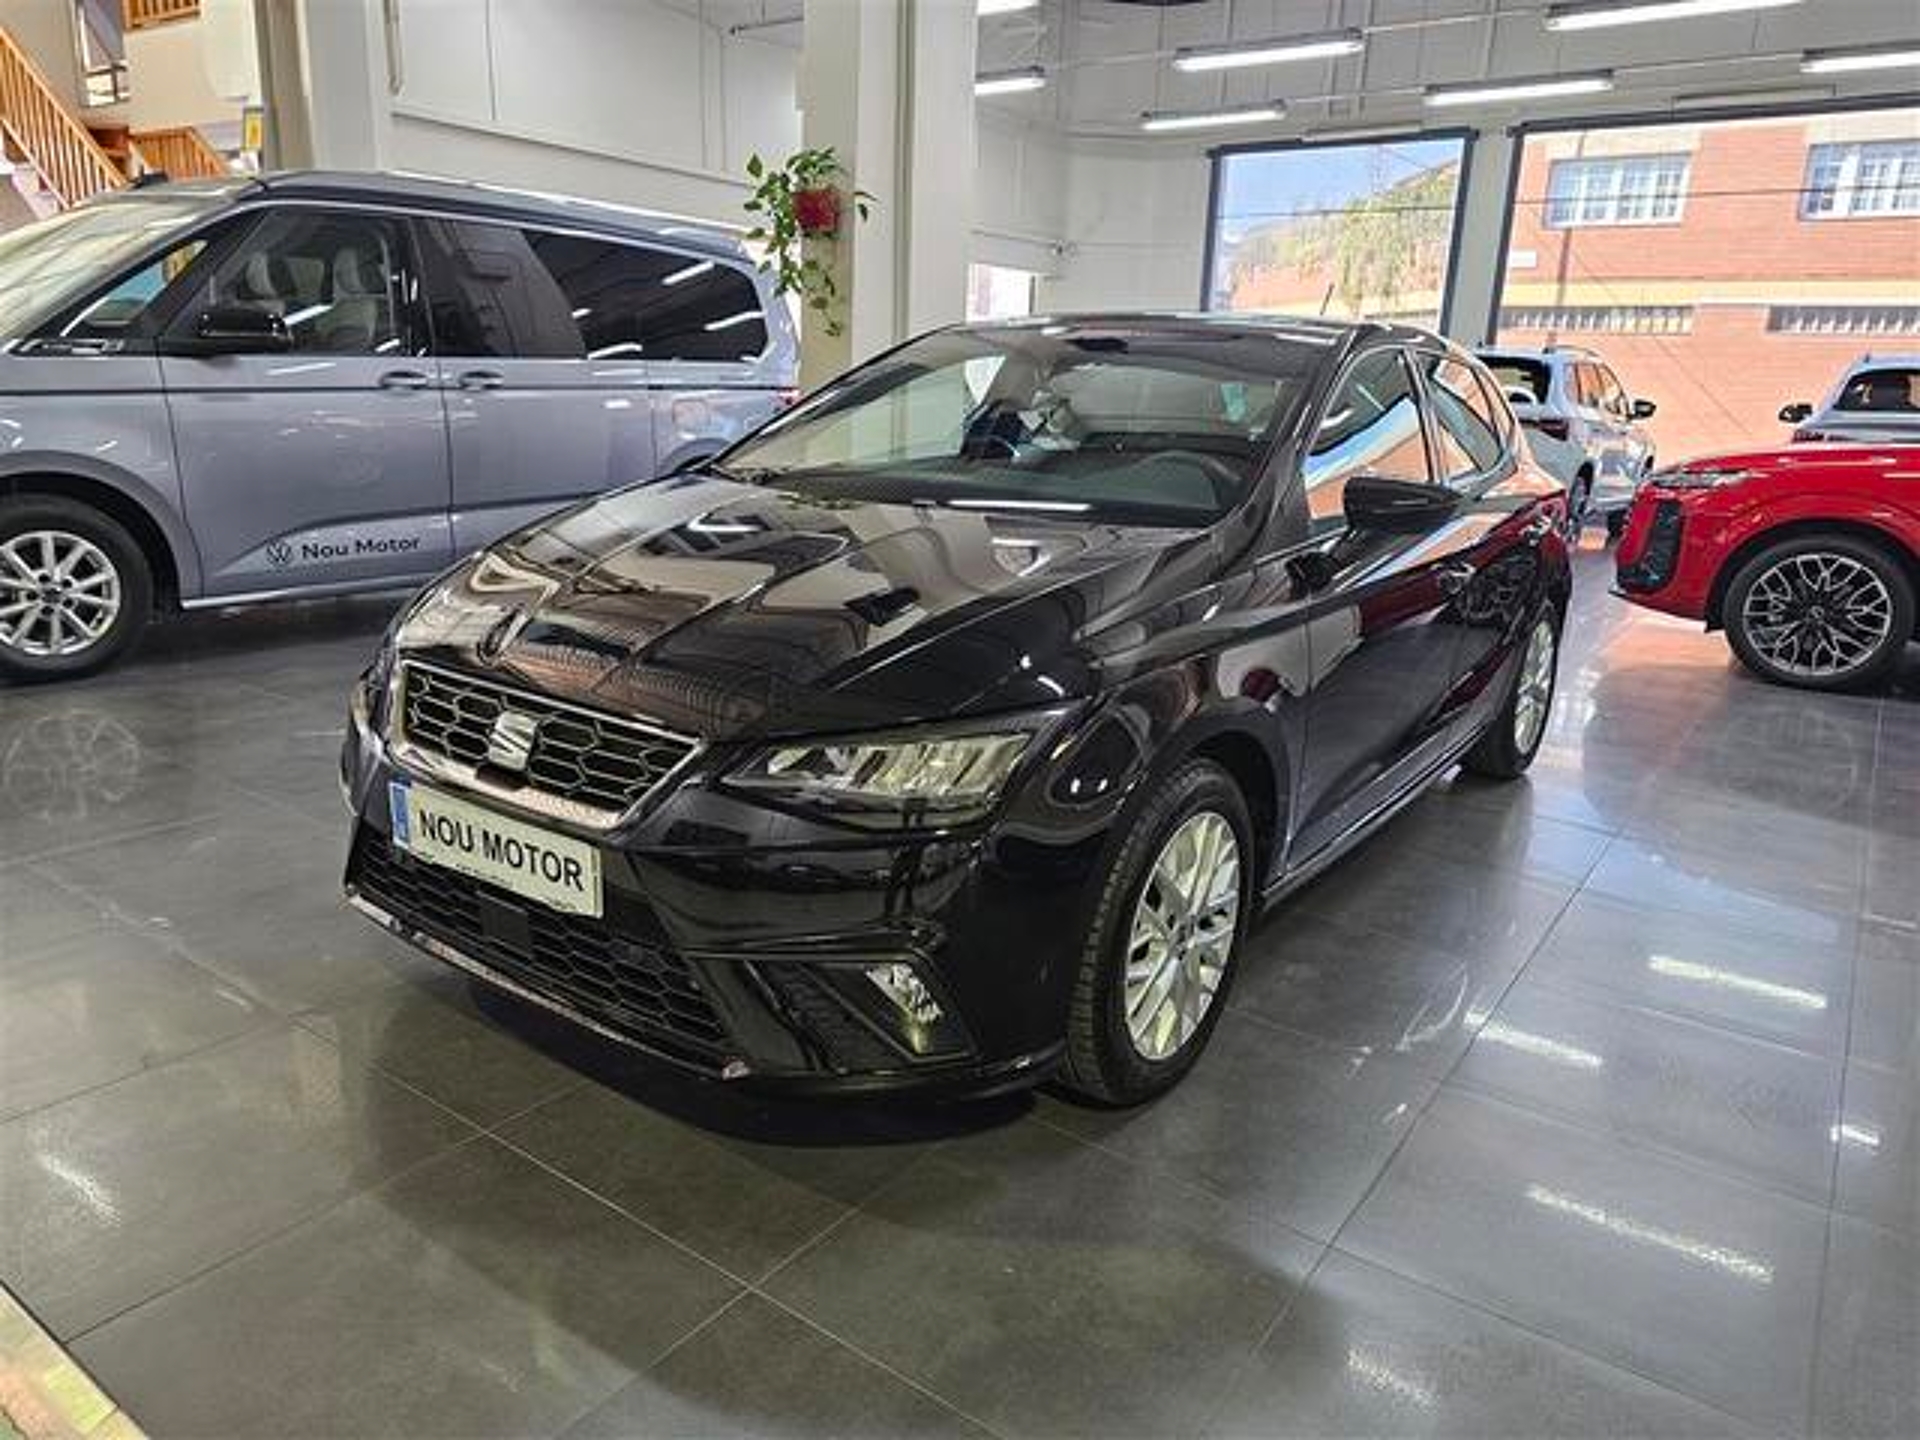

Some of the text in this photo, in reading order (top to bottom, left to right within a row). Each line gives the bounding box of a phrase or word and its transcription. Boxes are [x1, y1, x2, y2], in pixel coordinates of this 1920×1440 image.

[302, 537, 420, 559] Nou Motor
[420, 809, 474, 852] NOU
[482, 829, 585, 892] MOTOR
